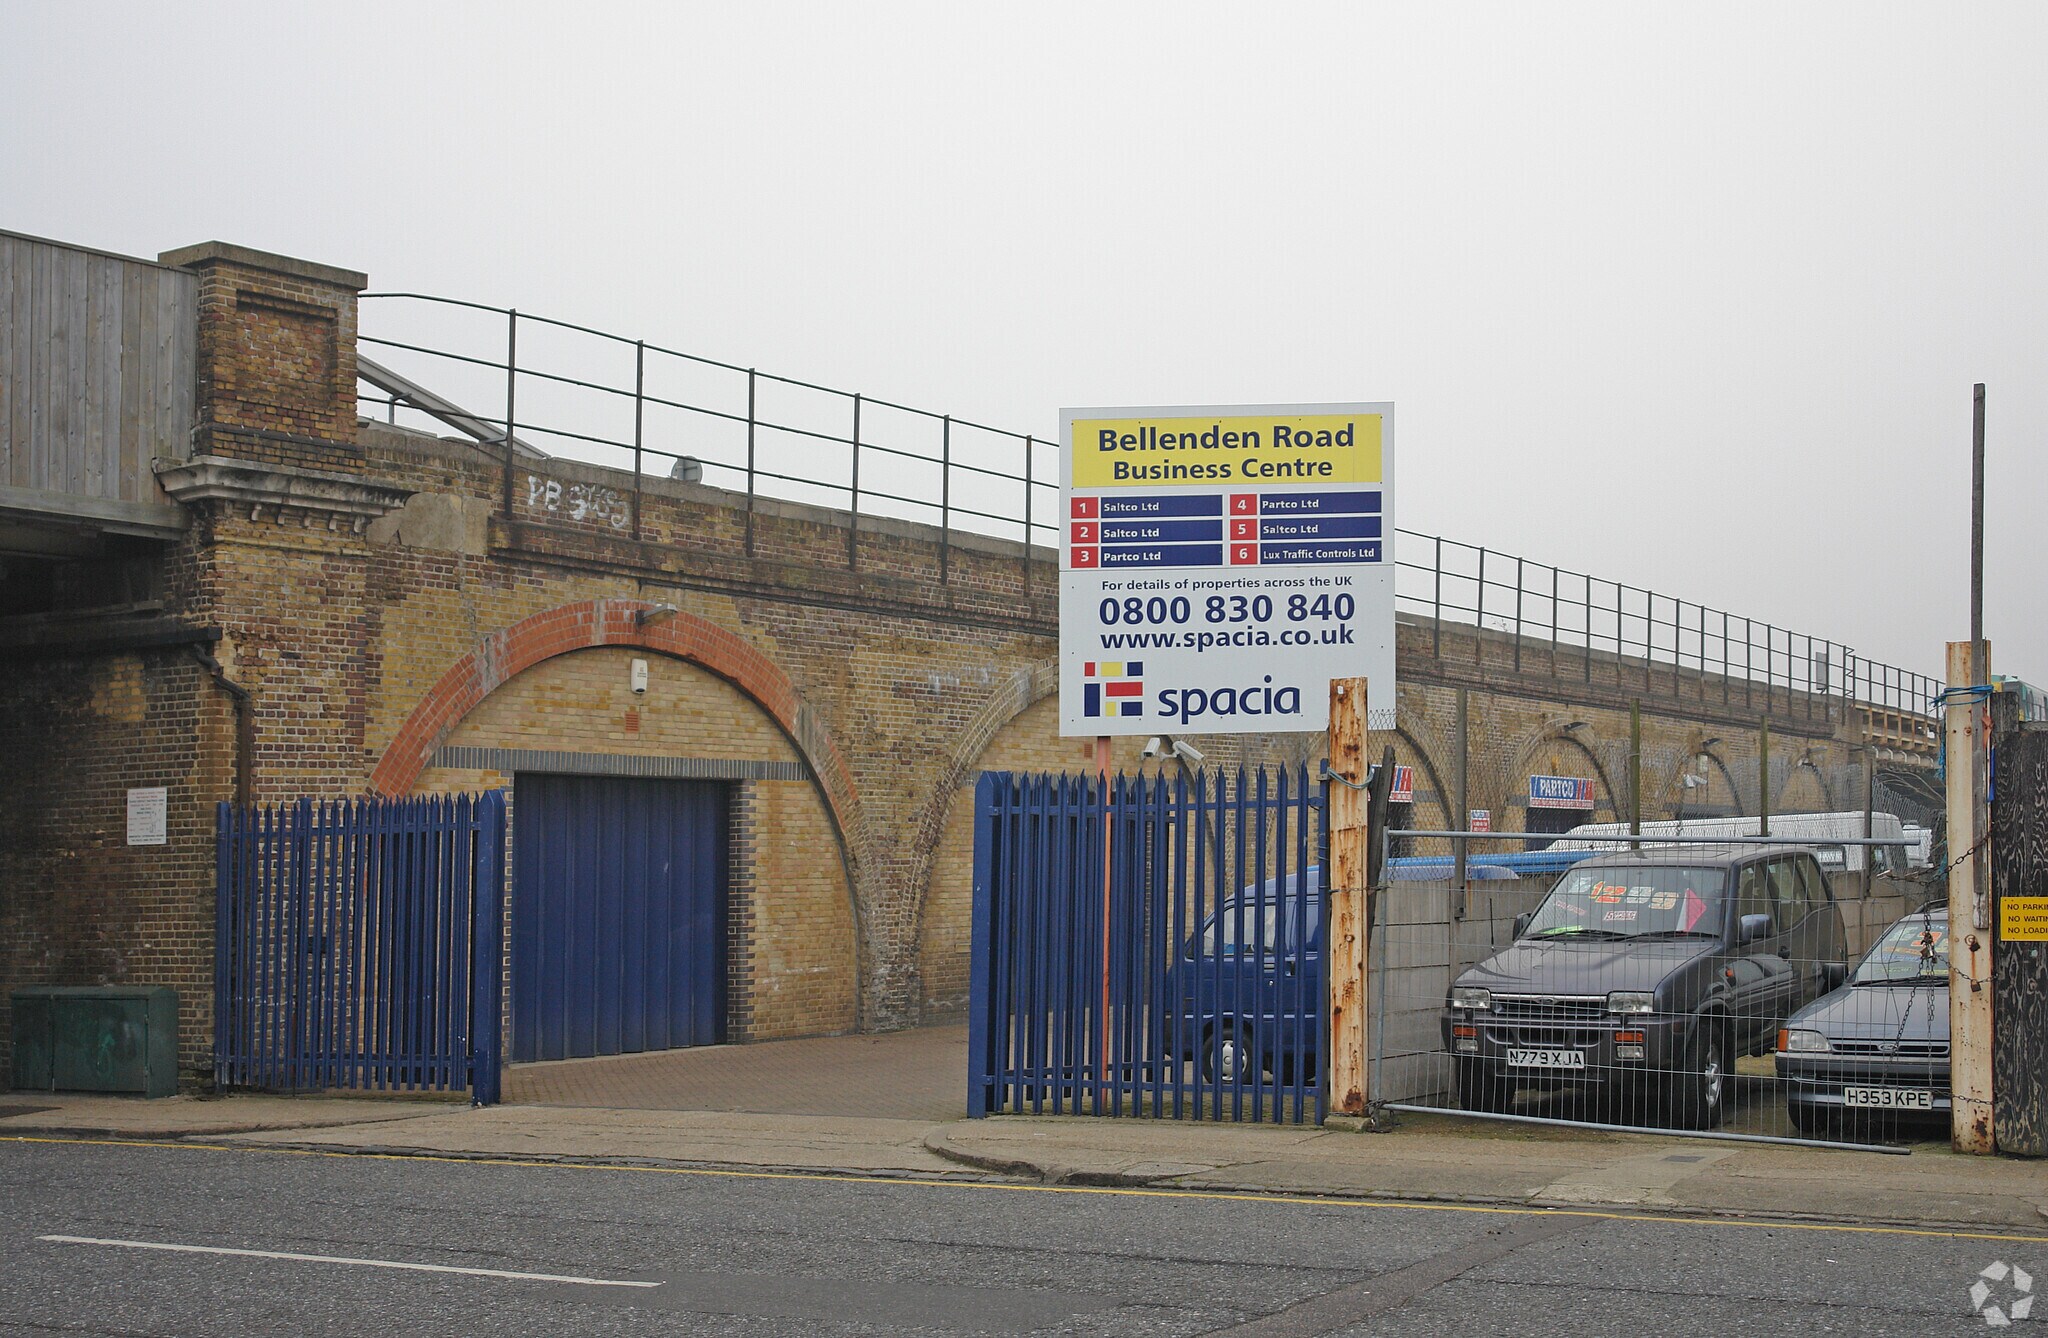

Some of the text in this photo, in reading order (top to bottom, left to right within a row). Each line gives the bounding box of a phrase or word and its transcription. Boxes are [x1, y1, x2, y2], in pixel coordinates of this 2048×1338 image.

[1099, 423, 1354, 451] Bellenden Road
[1114, 458, 1332, 479] Business Centre
[1079, 502, 1160, 514] 1 Saltco Ltd
[1237, 498, 1319, 510] 4 Partco Ltd
[1080, 526, 1160, 538] 2 Saltco Ltd
[1238, 523, 1319, 535] 5 Saltco Ltd
[1080, 550, 1161, 562] 3 Partco Ltd
[1239, 547, 1375, 560] 6 Lux Traffic Controls Ltd
[1102, 575, 1353, 592] For details of properties across the UK
[1099, 593, 1354, 625] 0800 830 840
[1100, 624, 1355, 652] www.spacia.co.uk
[1158, 675, 1301, 725] spacia
[1540, 779, 1575, 798] PARTCO
[1509, 1050, 1583, 1067] N779 XJA
[1847, 1089, 1929, 1107] H353 KPE
